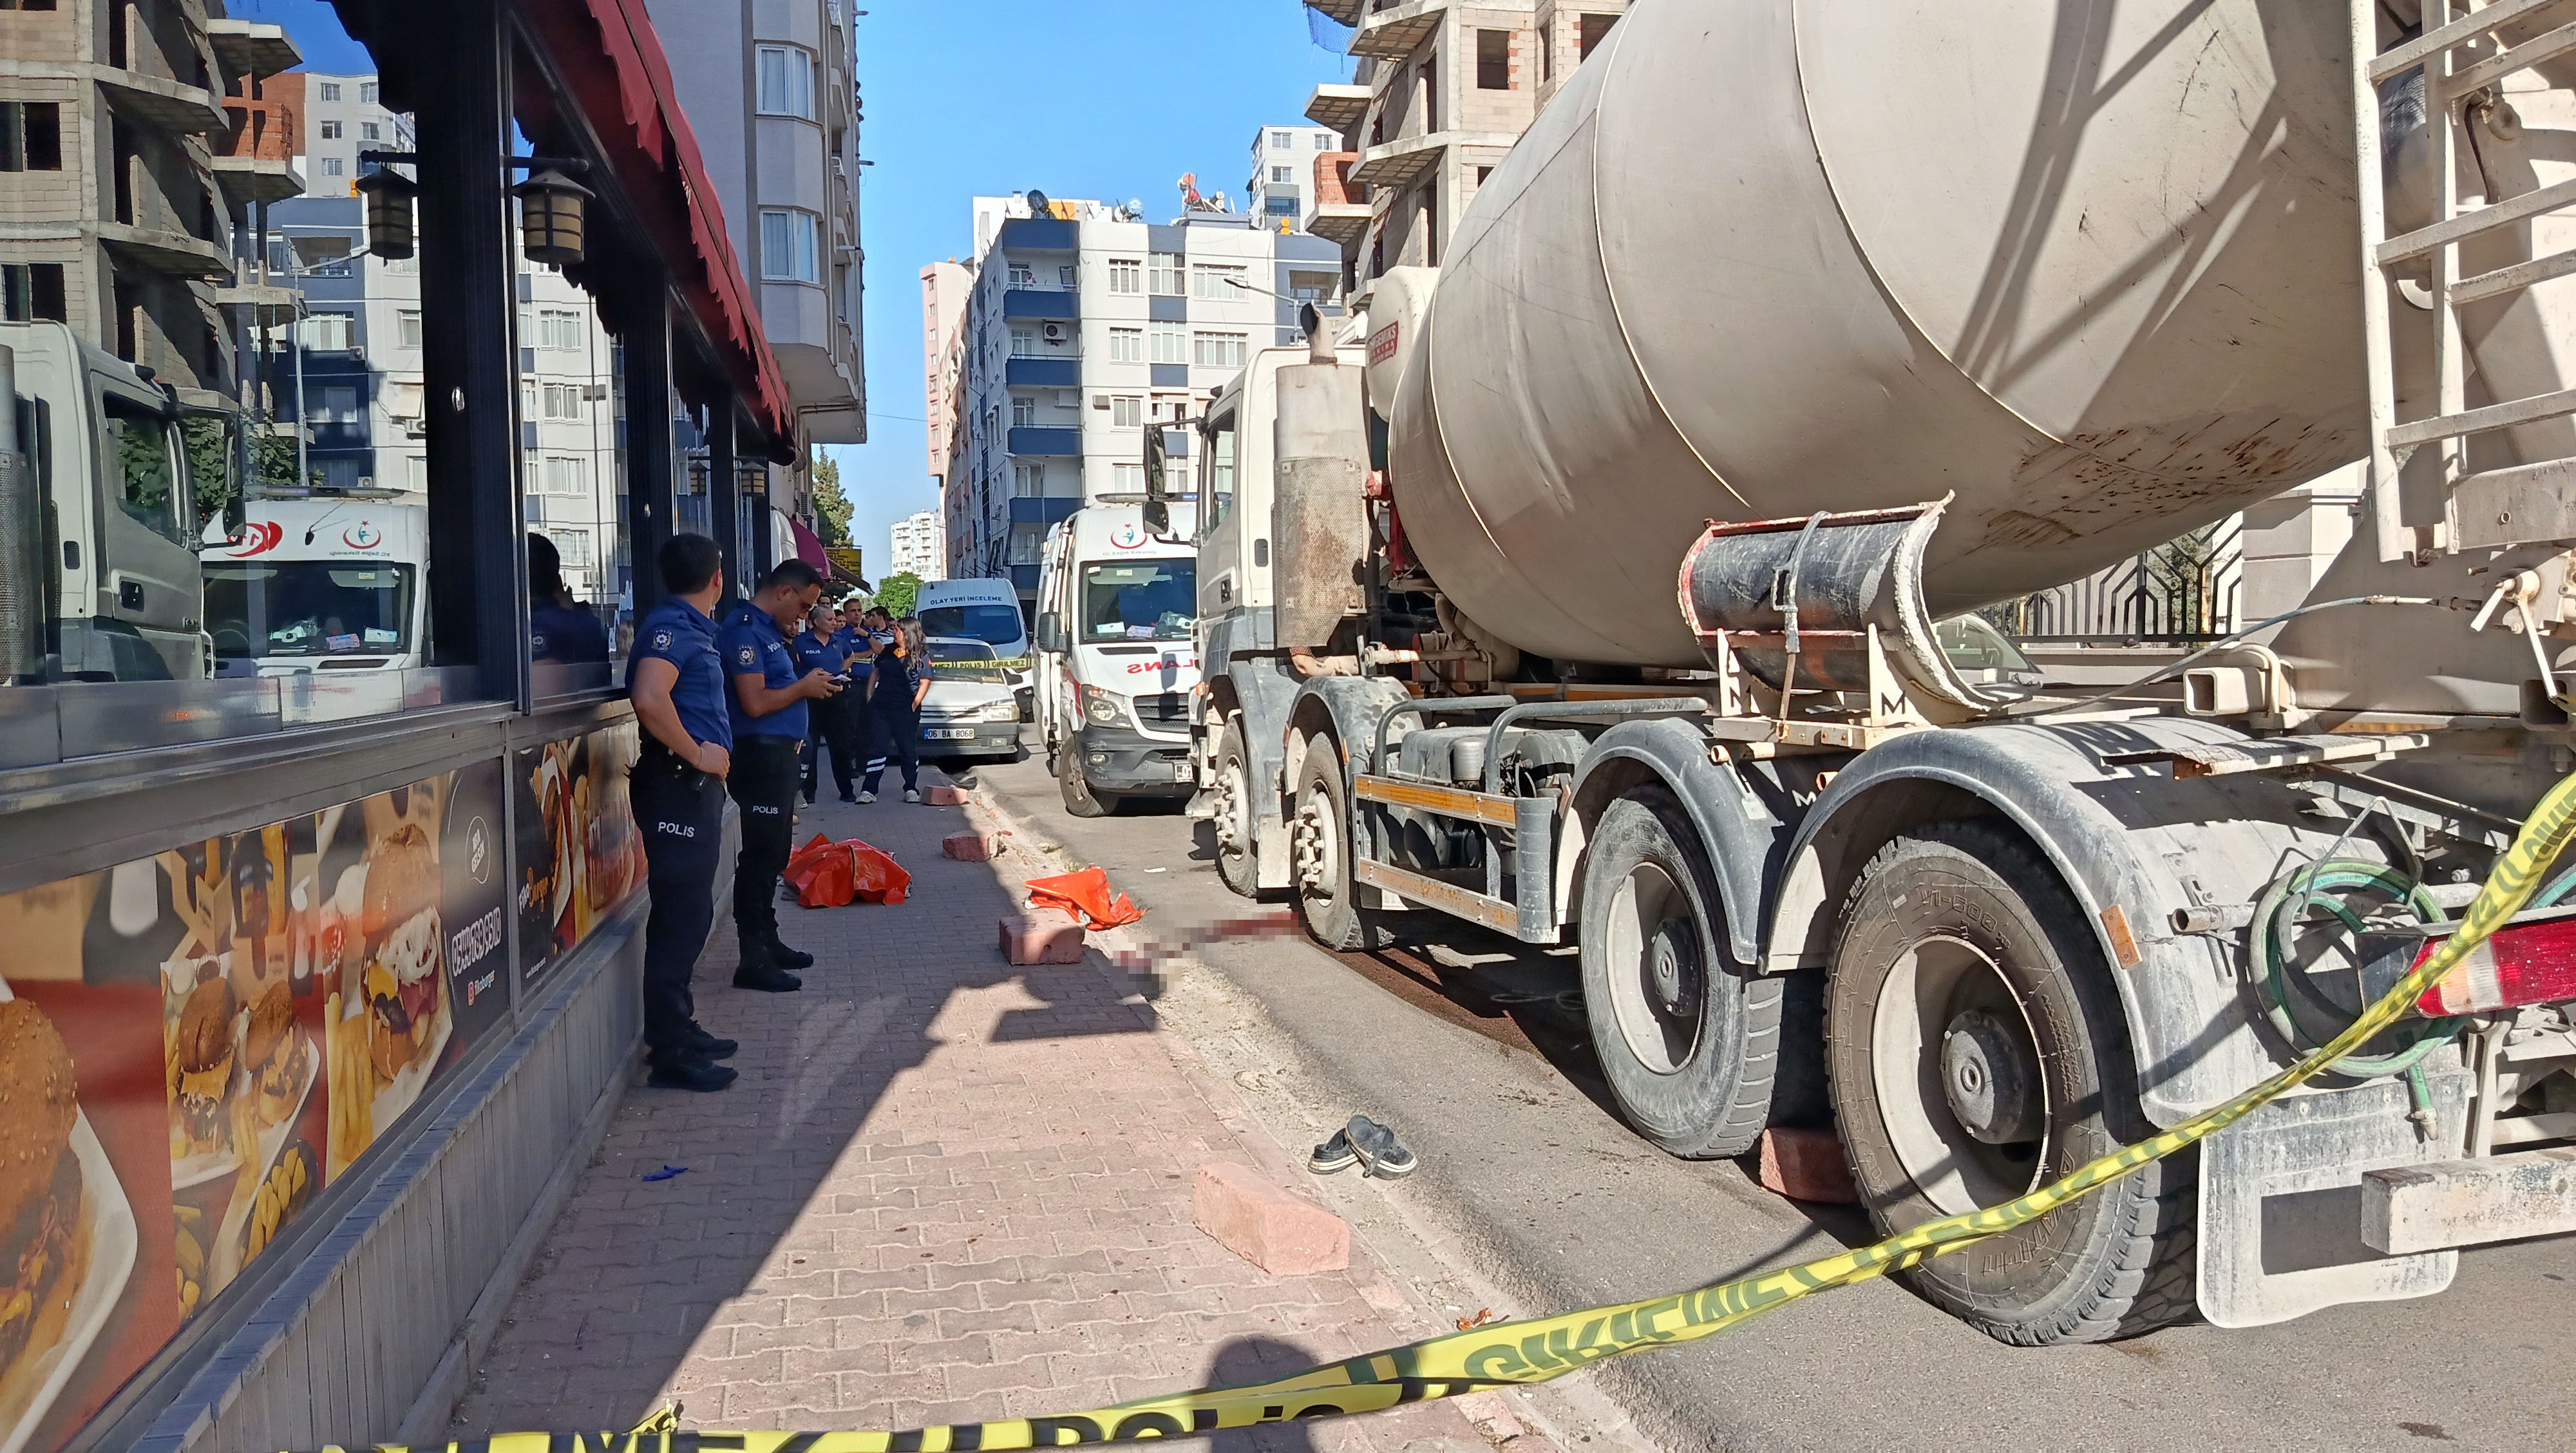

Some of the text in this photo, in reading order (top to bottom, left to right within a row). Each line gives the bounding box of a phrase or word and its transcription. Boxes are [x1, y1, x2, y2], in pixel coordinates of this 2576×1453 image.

[930, 597, 949, 605] OLAY
[928, 729, 974, 738] 06 BA 8068
[658, 821, 696, 839] POLIS
[475, 969, 495, 996] fikoburger
